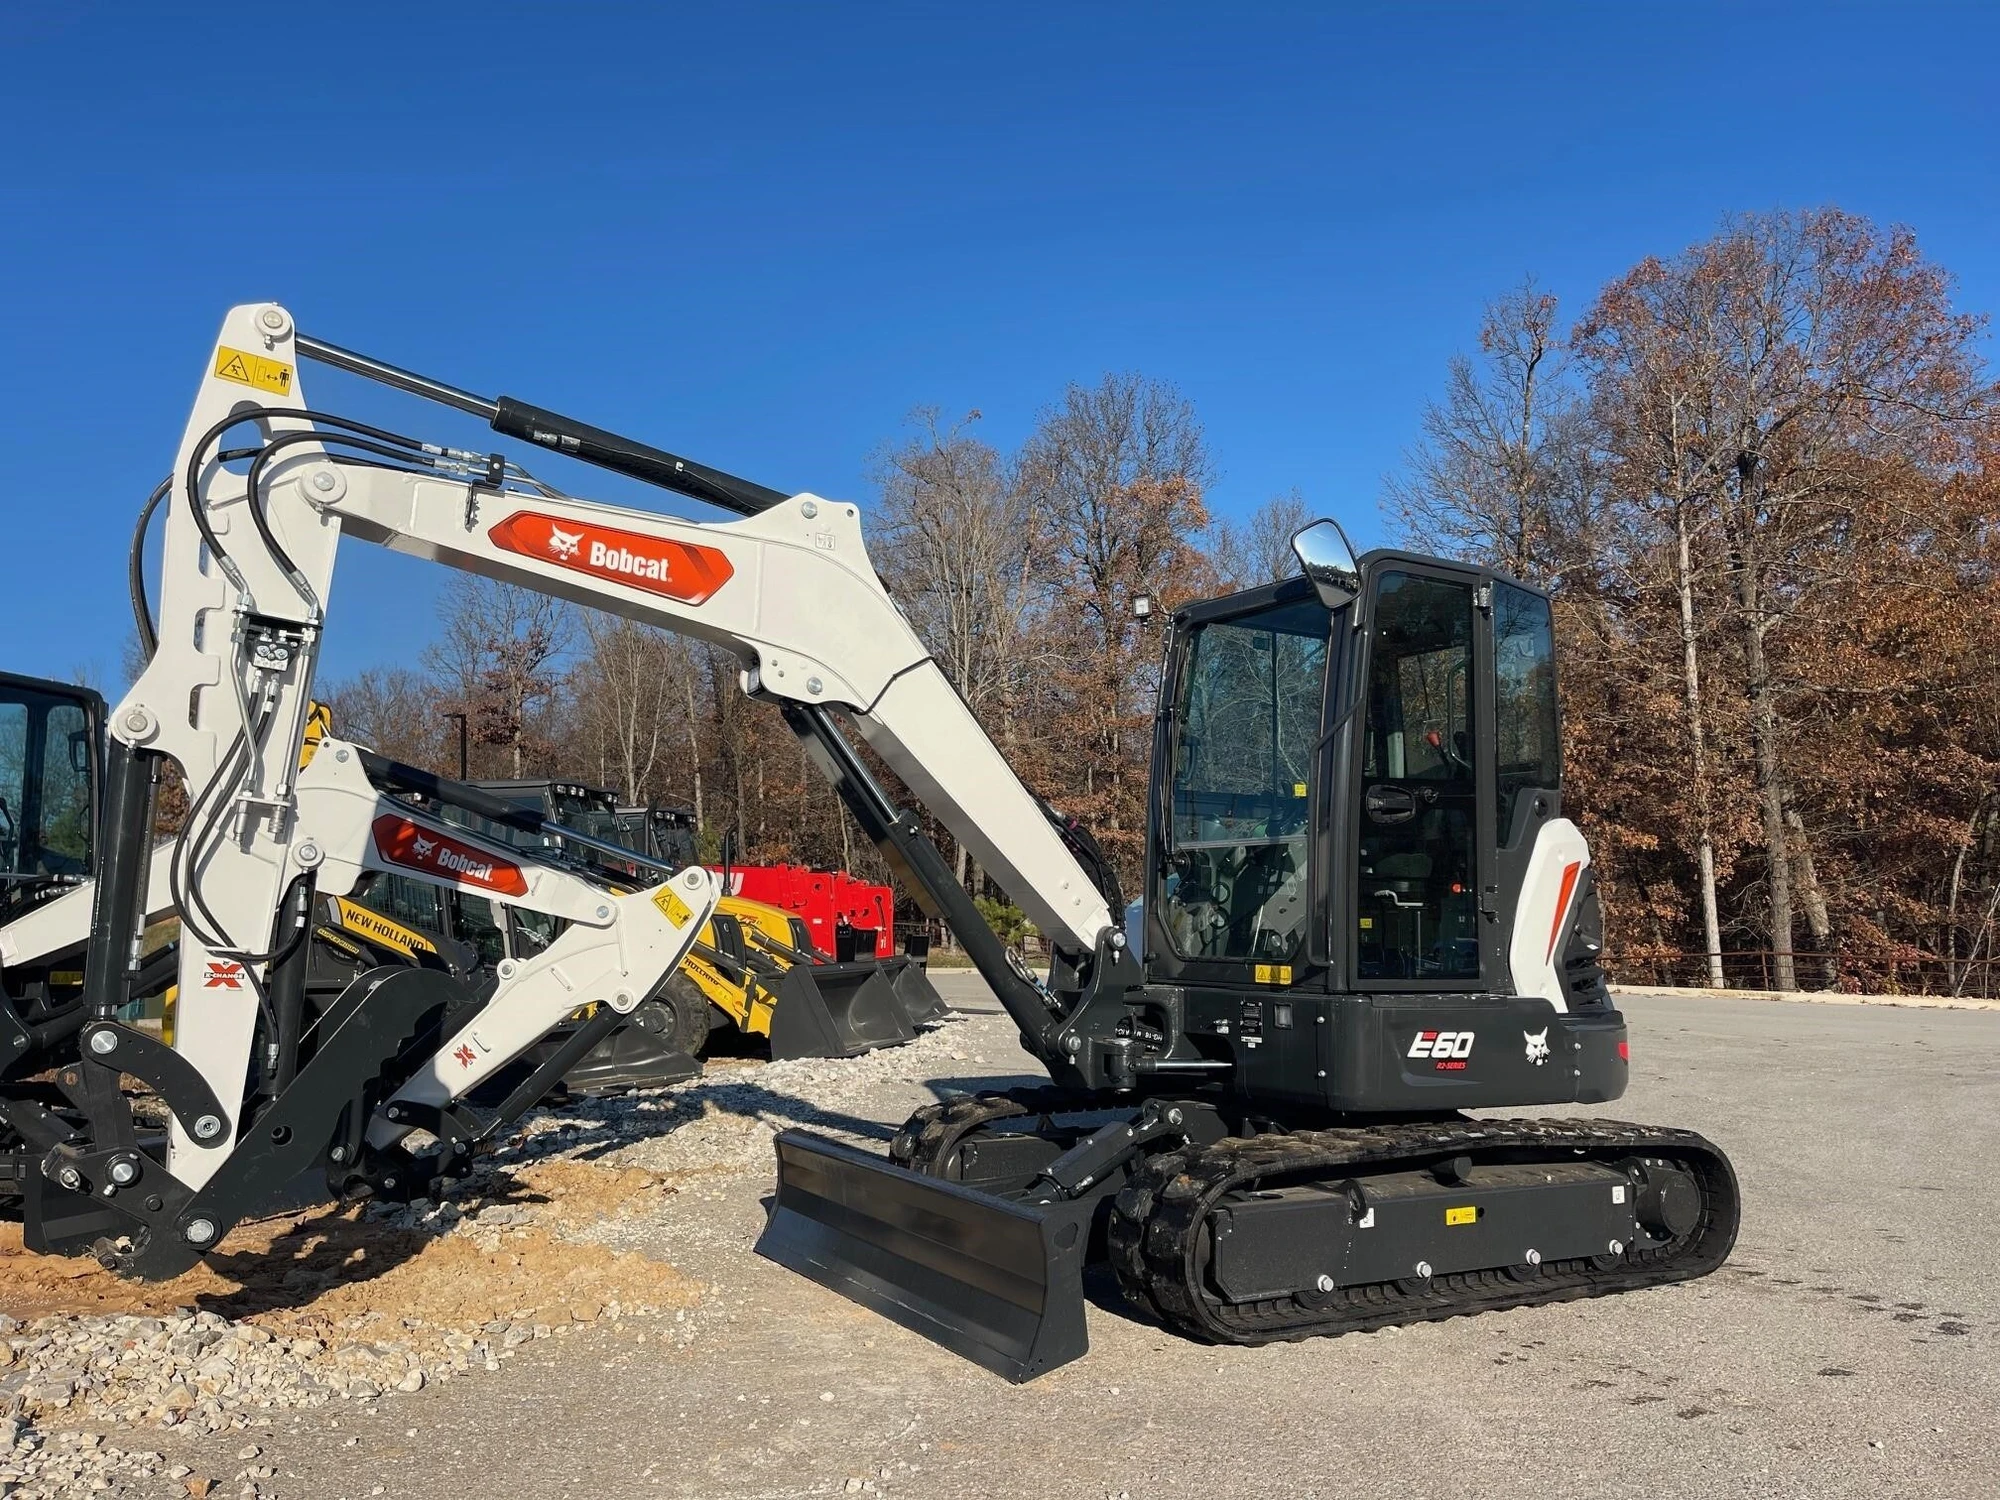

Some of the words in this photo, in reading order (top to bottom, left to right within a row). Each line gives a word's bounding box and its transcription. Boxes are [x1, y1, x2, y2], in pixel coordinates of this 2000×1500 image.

[590, 541, 669, 582] Bobcat
[437, 847, 493, 882] Bobcat
[346, 909, 373, 928] NEW
[372, 921, 425, 950] HOLLAND
[1407, 1031, 1475, 1058] E60
